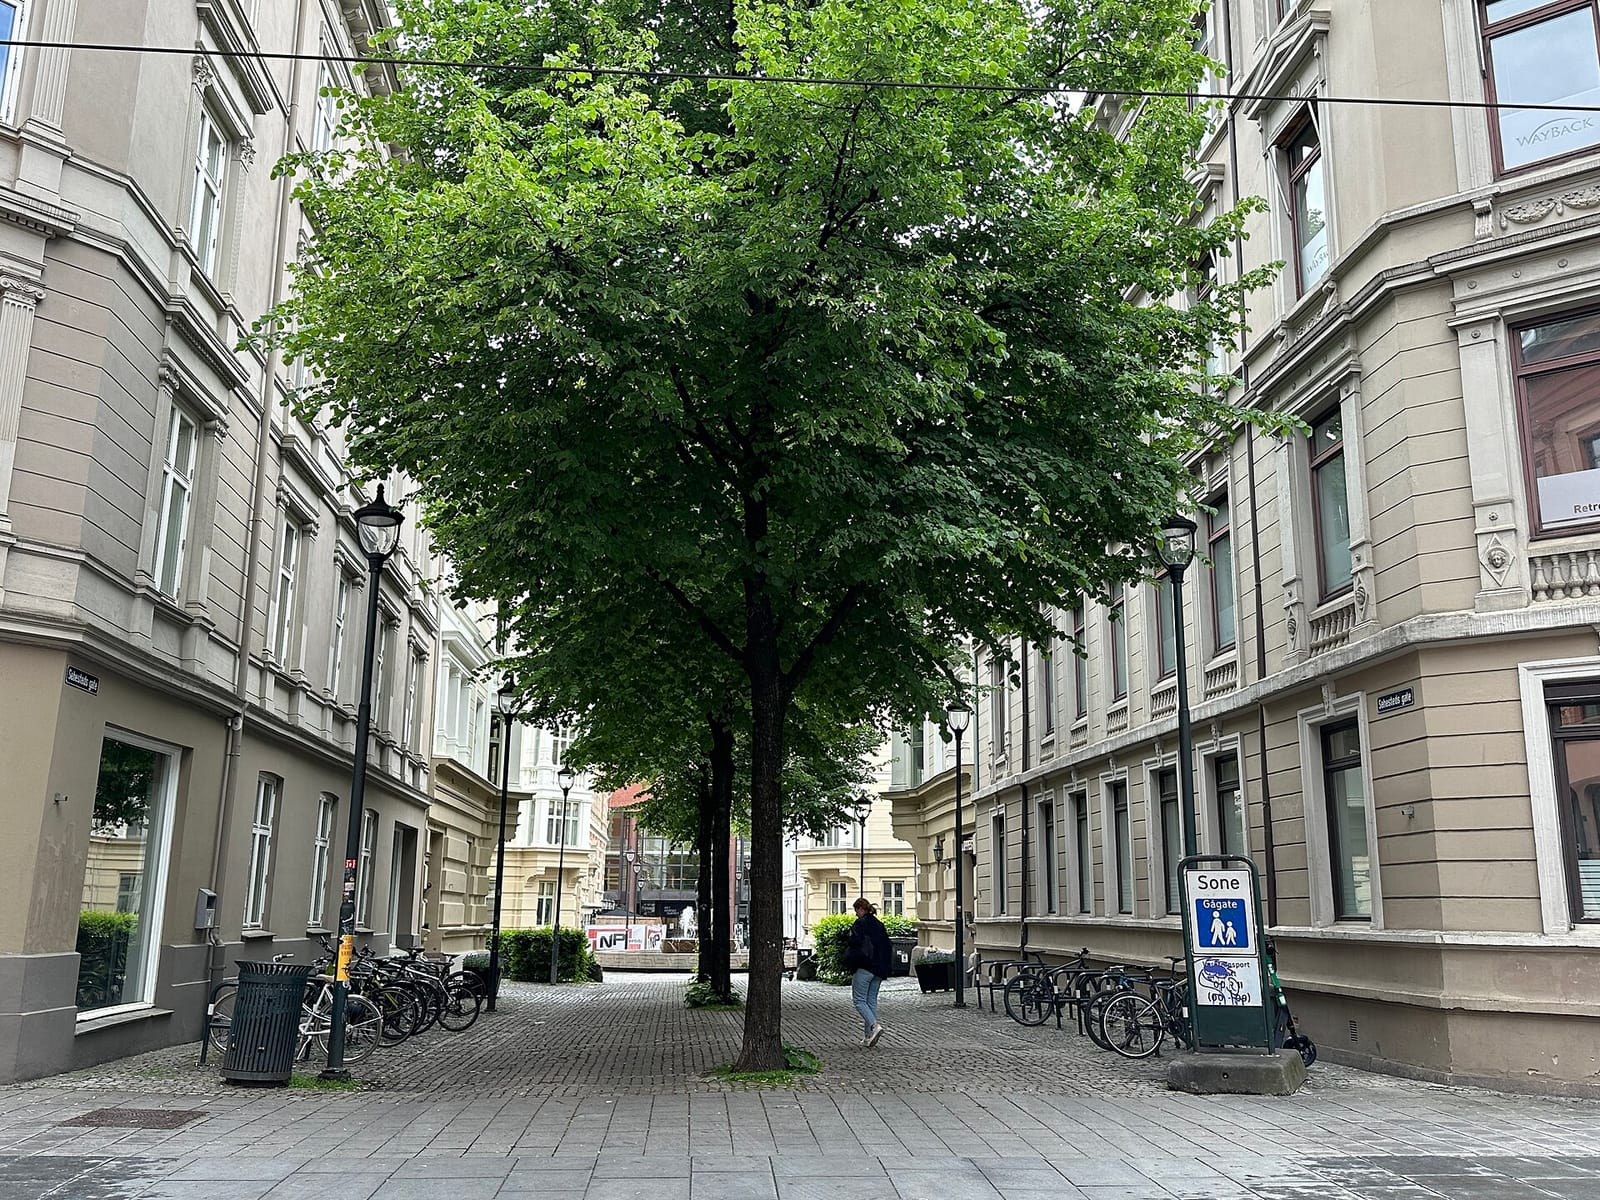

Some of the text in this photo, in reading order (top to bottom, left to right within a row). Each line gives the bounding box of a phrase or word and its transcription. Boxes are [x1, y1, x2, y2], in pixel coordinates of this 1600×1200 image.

[1516, 116, 1594, 146] WAYBACK
[1401, 692, 1412, 706] gate
[1197, 874, 1240, 890] Sone
[1203, 899, 1238, 911] Gågate
